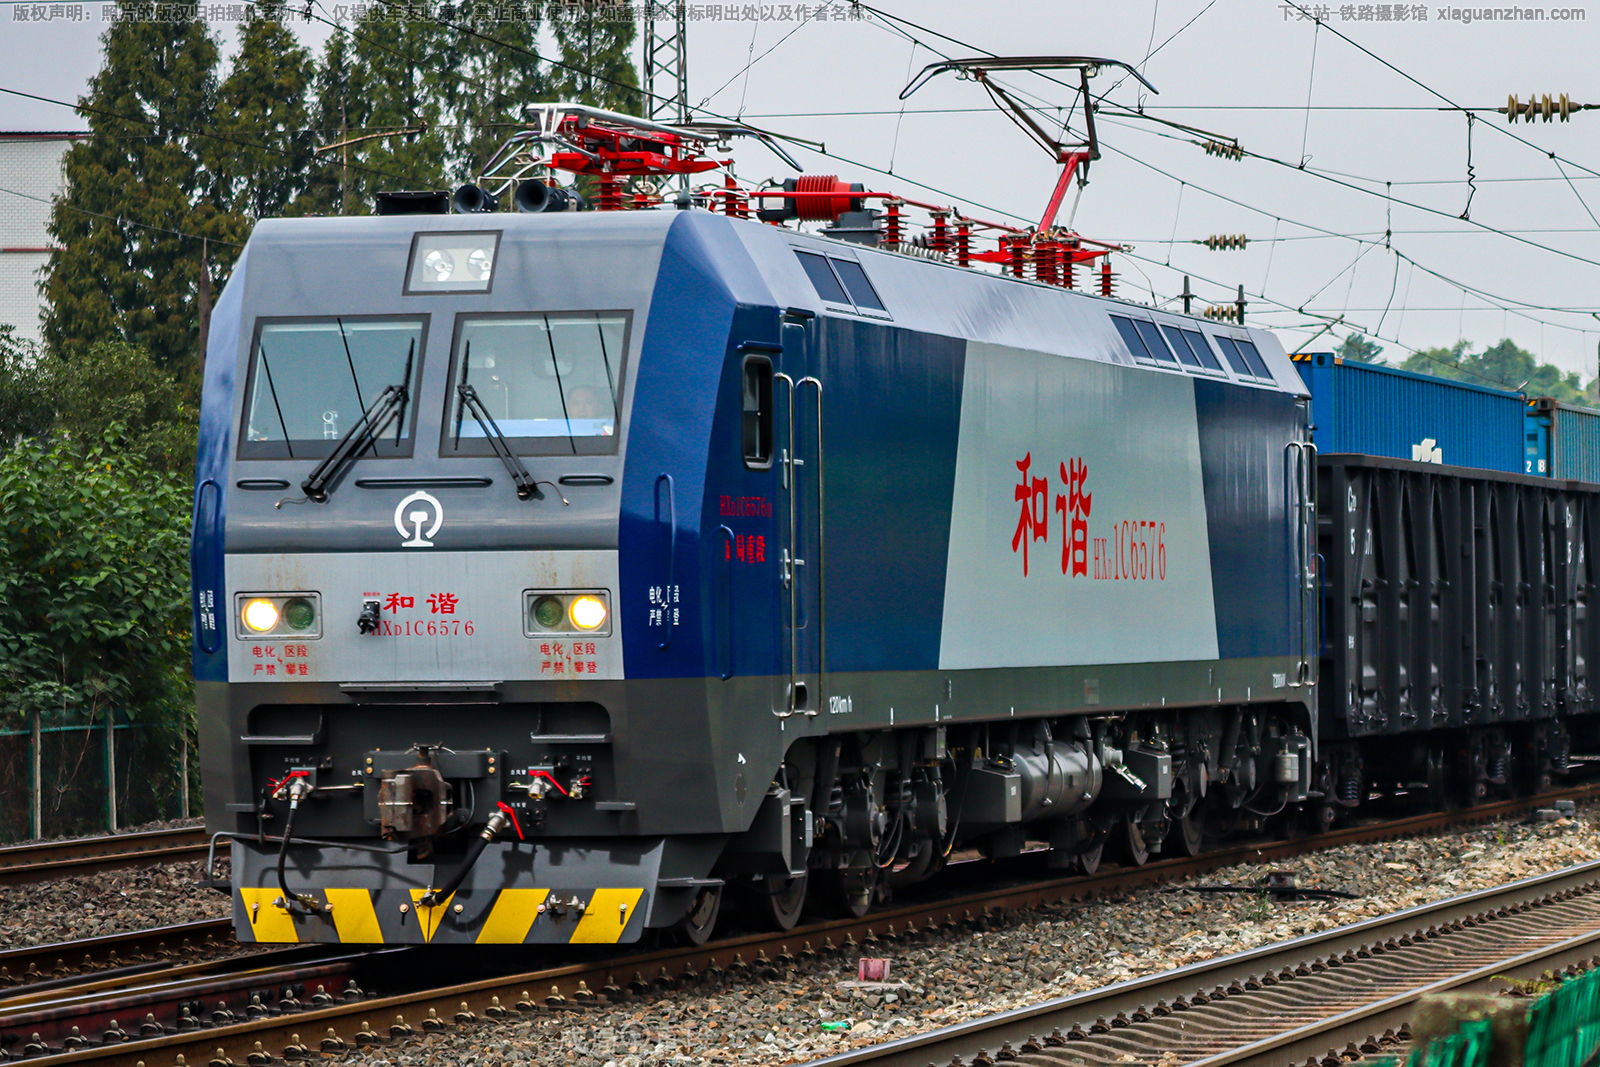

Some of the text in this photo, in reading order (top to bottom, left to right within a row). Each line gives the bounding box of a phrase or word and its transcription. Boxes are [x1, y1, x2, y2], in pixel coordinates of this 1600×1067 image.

[1012, 451, 1092, 578] 和谐
[383, 592, 459, 614] 和谐
[252, 645, 308, 658] 电化 区段
[540, 642, 597, 656] 电化 区段
[253, 663, 276, 676] 严禁
[541, 661, 564, 673] 严禁
